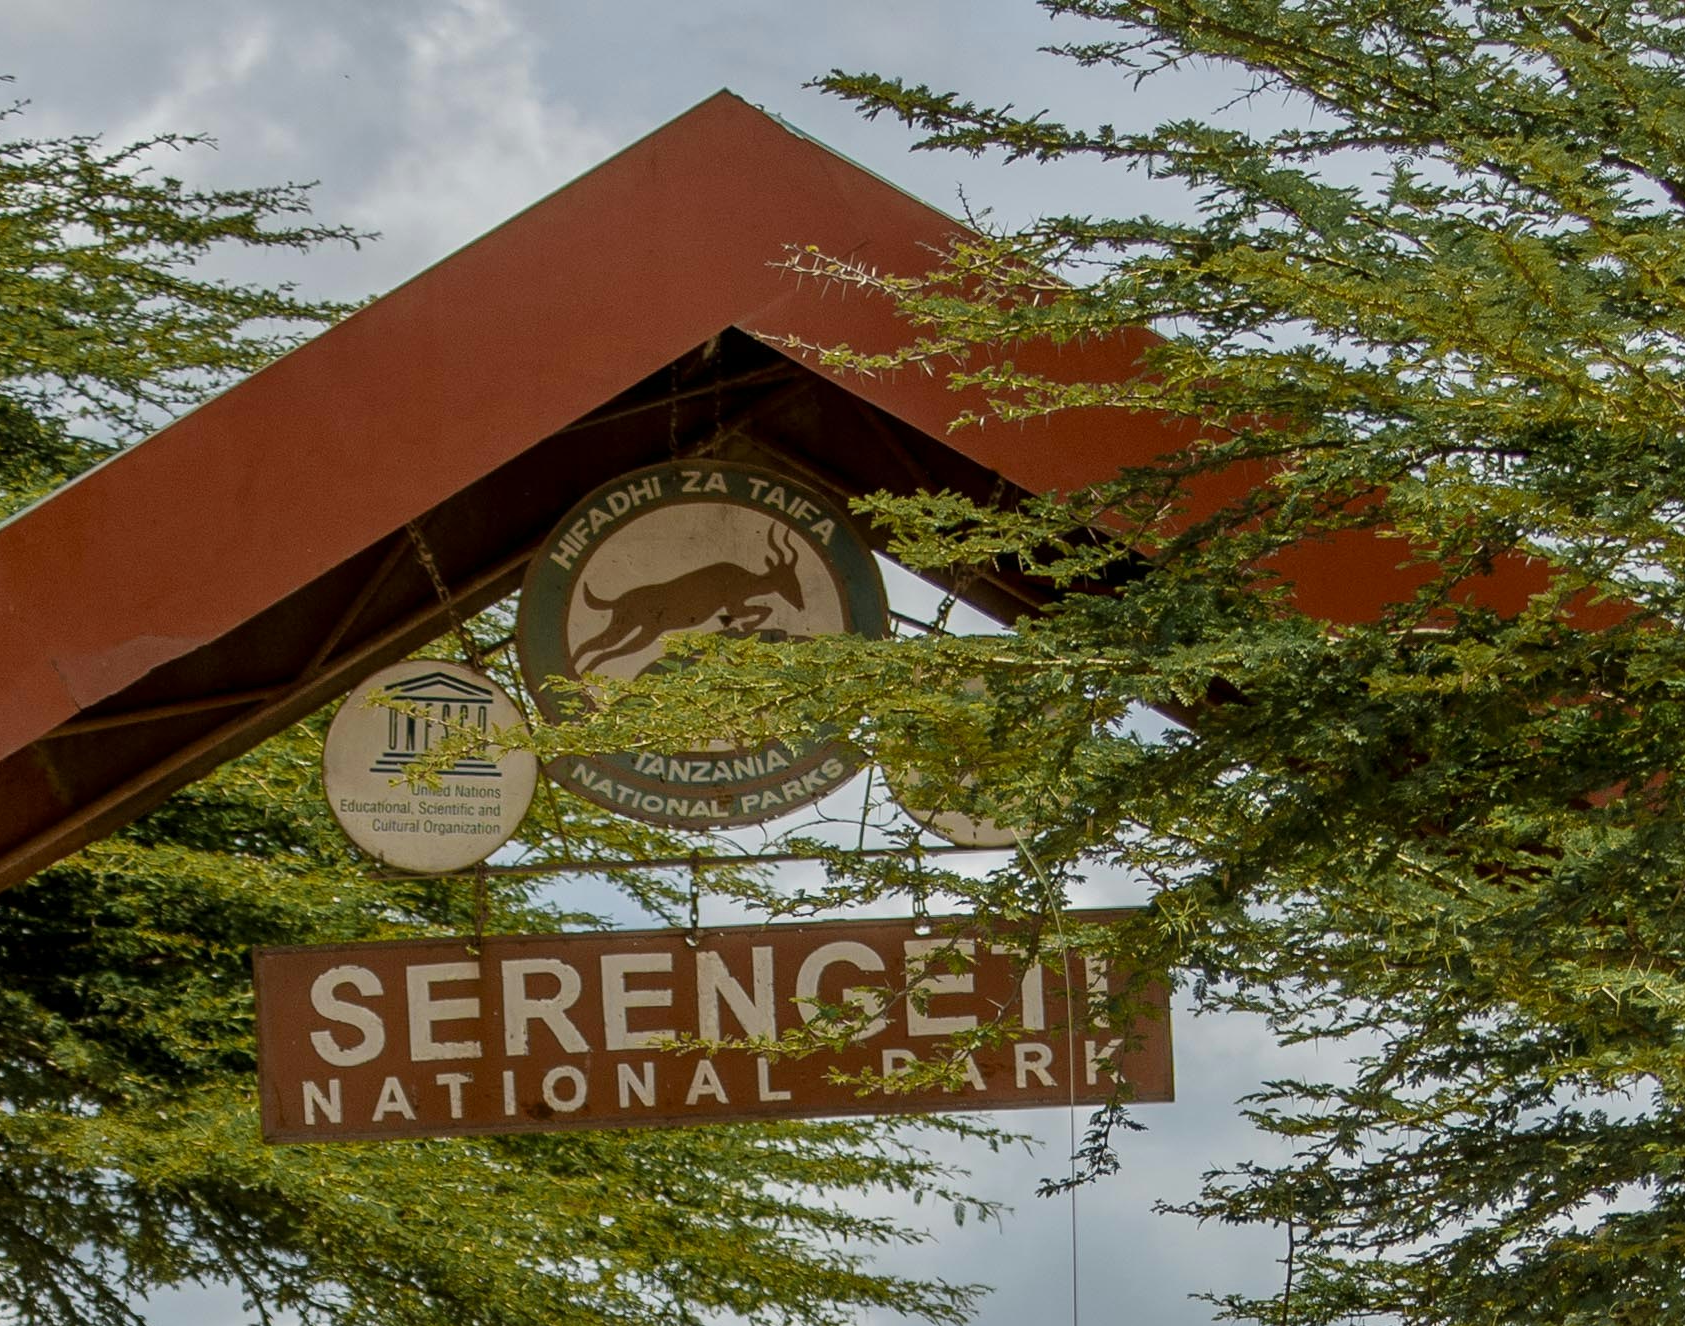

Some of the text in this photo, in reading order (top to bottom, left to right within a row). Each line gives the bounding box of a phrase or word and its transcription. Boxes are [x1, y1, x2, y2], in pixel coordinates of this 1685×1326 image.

[550, 470, 838, 570] HIFADHI ZA TAIFA
[570, 756, 845, 818] NATIONAL PARKS
[633, 749, 791, 783] TANZANIA
[339, 799, 501, 817] Educational, Scientific and
[454, 784, 502, 798] Nations
[371, 818, 501, 836] Cultural Organization
[309, 938, 1111, 1068] SERENGETI
[301, 1038, 1126, 1126] NATIONAL PARK
